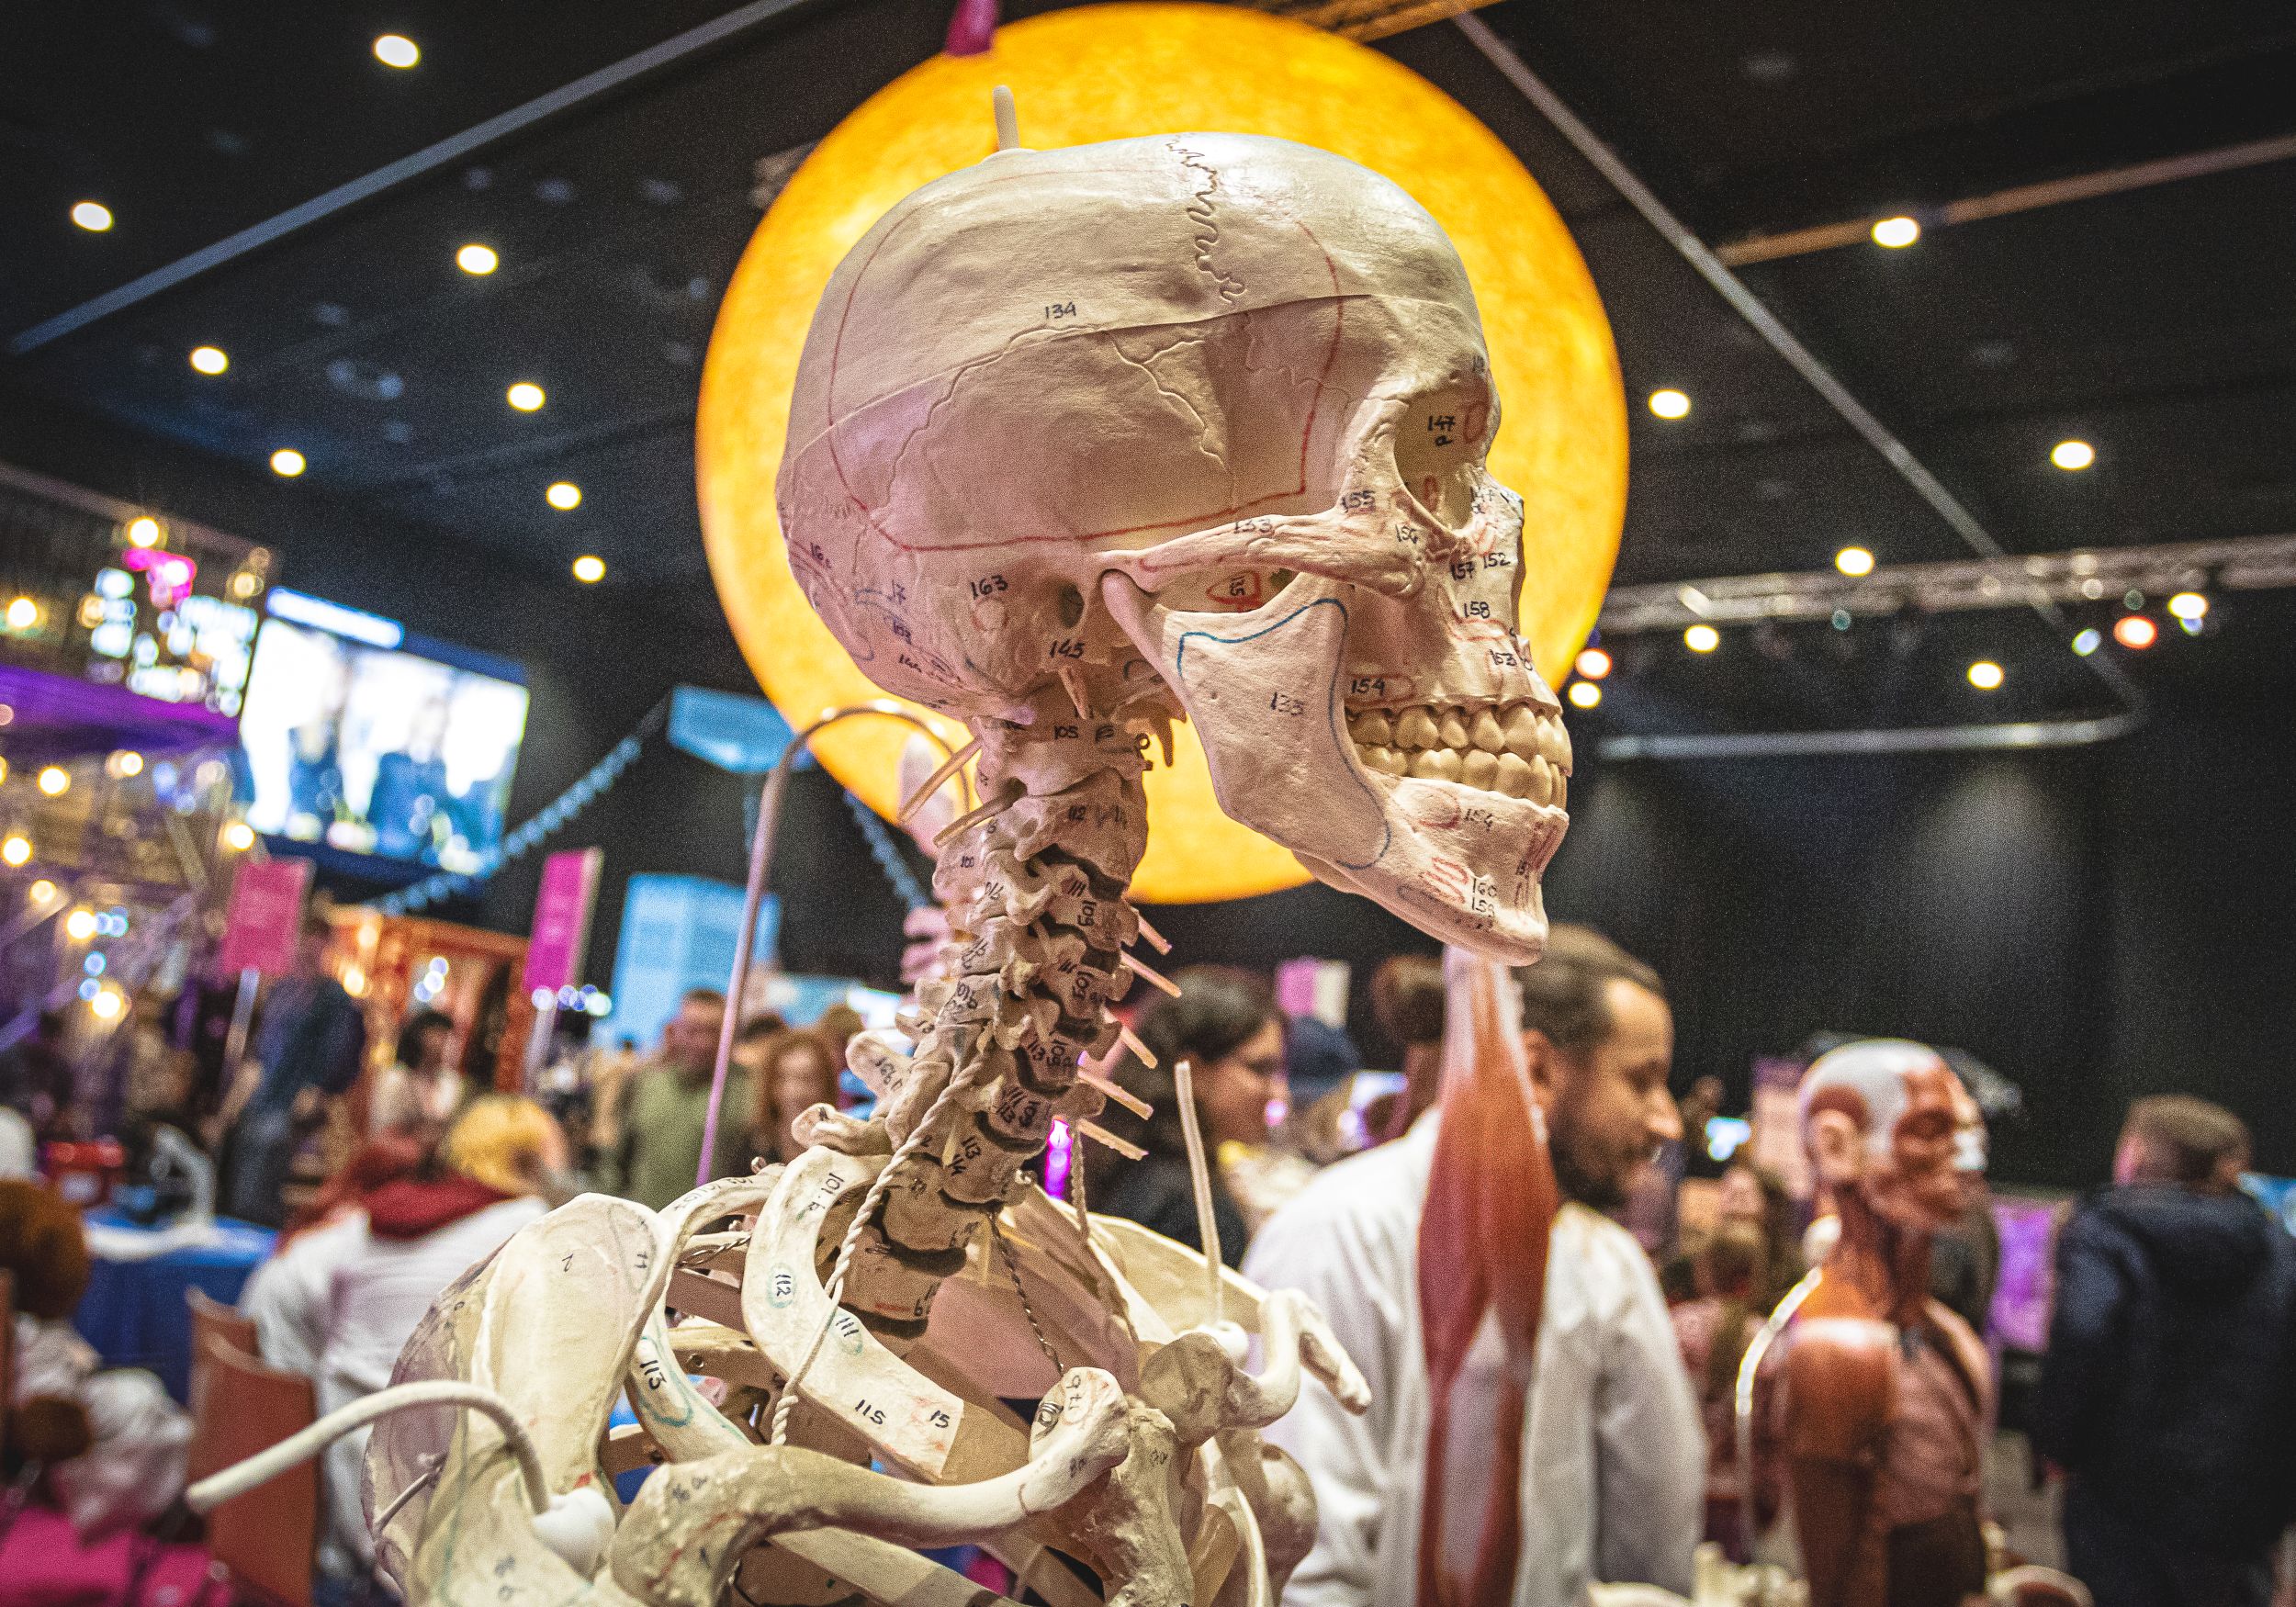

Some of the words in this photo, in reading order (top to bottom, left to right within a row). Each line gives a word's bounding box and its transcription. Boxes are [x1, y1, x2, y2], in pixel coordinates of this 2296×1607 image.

[1045, 300, 1077, 320] 134
[1428, 414, 1456, 433] 147
[1483, 553, 1510, 569] 152
[971, 575, 1008, 600] 163
[1464, 601, 1491, 620] 158
[1351, 678, 1386, 696] 154
[774, 1272, 793, 1298] 112
[639, 1359, 669, 1390] 113
[855, 1399, 886, 1425] 115
